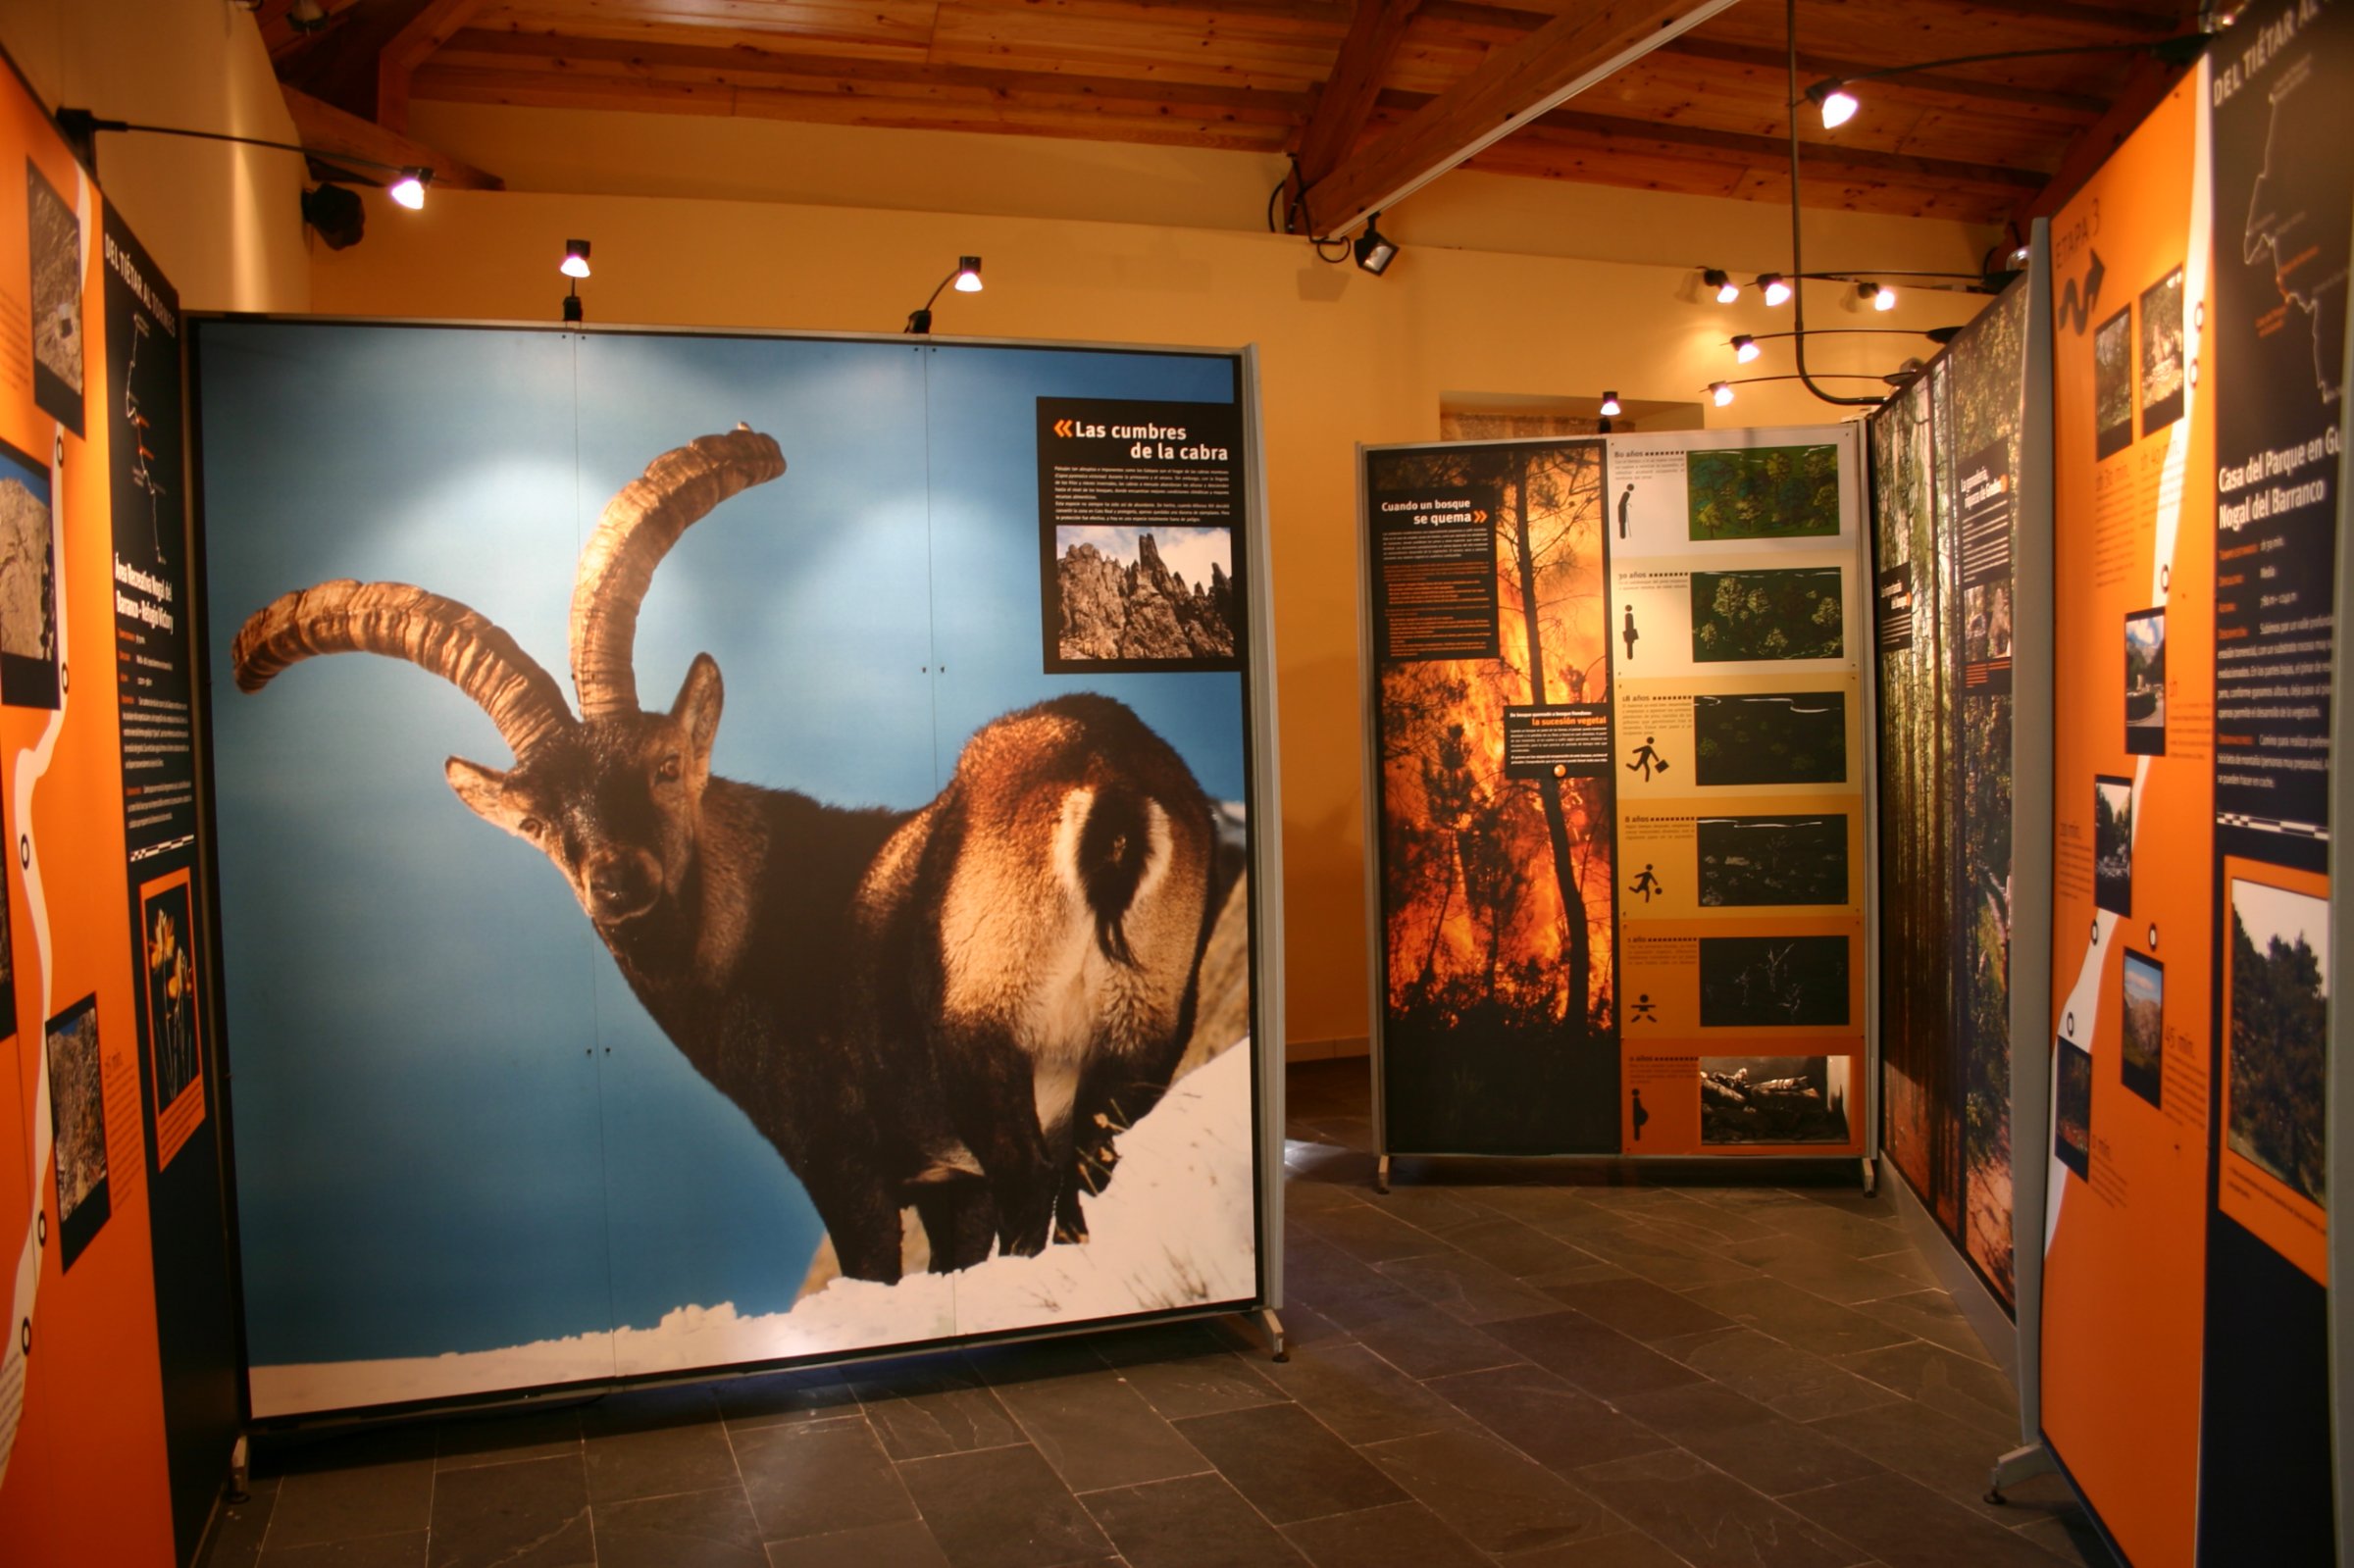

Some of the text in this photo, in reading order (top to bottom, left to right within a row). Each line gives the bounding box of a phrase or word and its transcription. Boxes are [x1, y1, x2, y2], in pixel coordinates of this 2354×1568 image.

[2213, 63, 2241, 108] DEL
[2242, 9, 2296, 79] TIÉTAR
[104, 233, 120, 271] DEL
[120, 251, 143, 300] TIÉTAR
[1075, 421, 1187, 440] Las cumbres
[1130, 441, 1228, 461] de la cabra
[2219, 467, 2244, 492] Casa
[2245, 452, 2264, 484] del
[2266, 443, 2306, 478] Parque
[2307, 437, 2323, 462] en
[1381, 499, 1471, 512] Cuando un bosque
[2219, 480, 2325, 531] Nogal del Barranco
[1413, 513, 1471, 526] se quema
[1532, 716, 1607, 728] la sucesión vegetal
